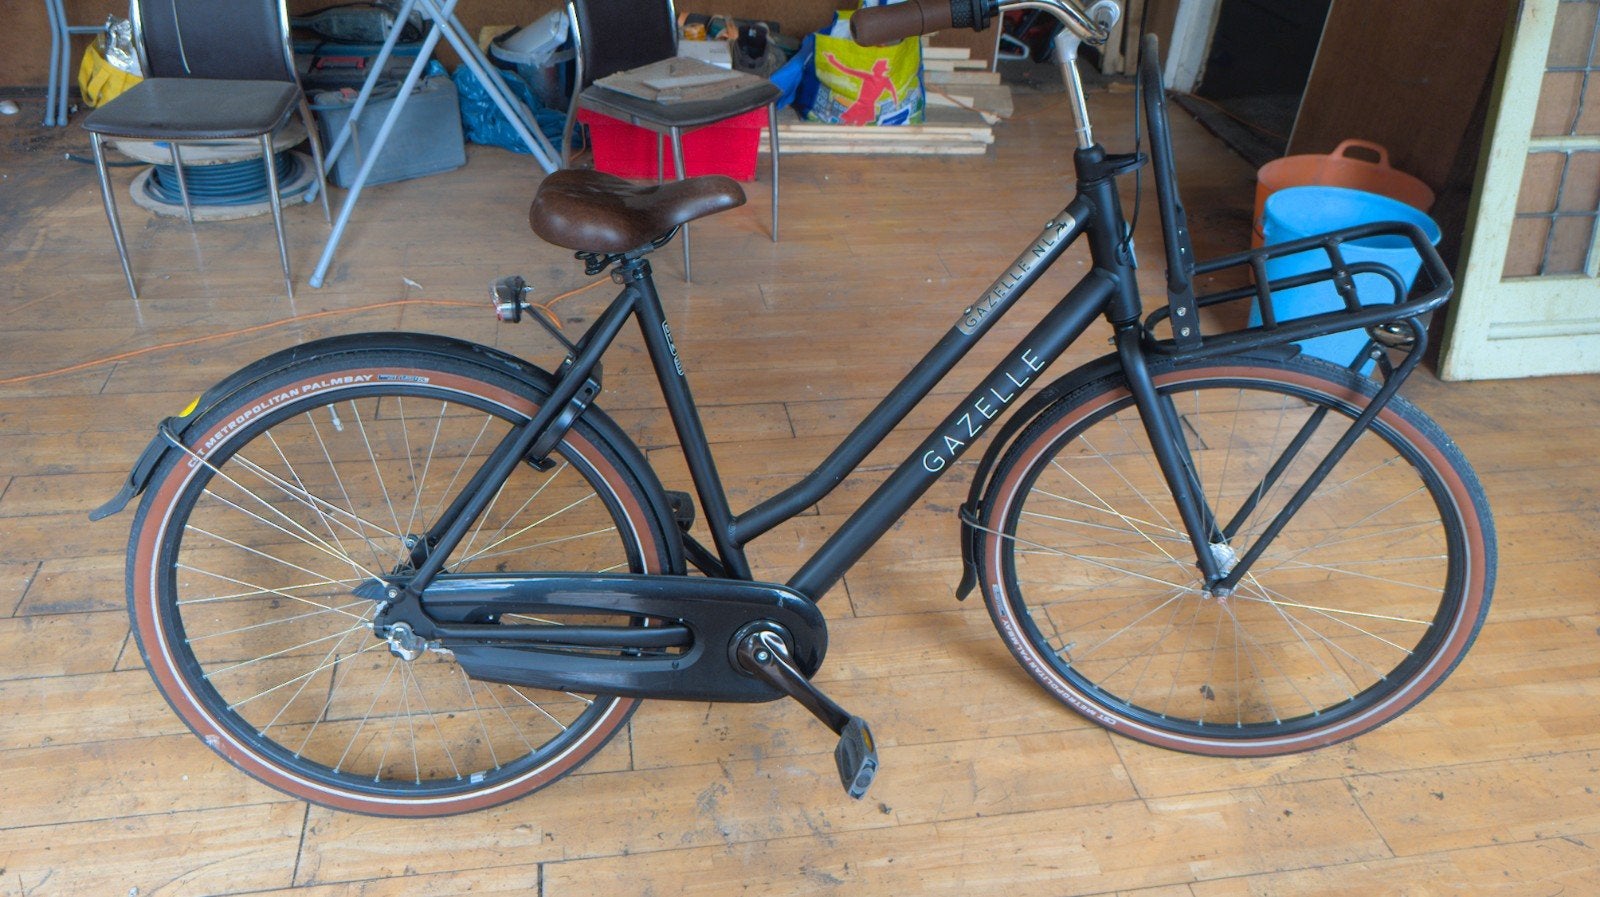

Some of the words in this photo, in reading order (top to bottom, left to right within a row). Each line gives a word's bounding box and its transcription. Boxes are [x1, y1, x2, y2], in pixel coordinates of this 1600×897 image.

[964, 260, 1031, 328] GAZELLE
[1032, 238, 1055, 258] NL
[205, 387, 300, 449] METROPOLITAN
[302, 374, 374, 393] PALMBAY
[923, 348, 1045, 472] GAZELLE
[1002, 619, 1031, 662] PALMBAY
[1029, 662, 1096, 716] METROPOLITAN
